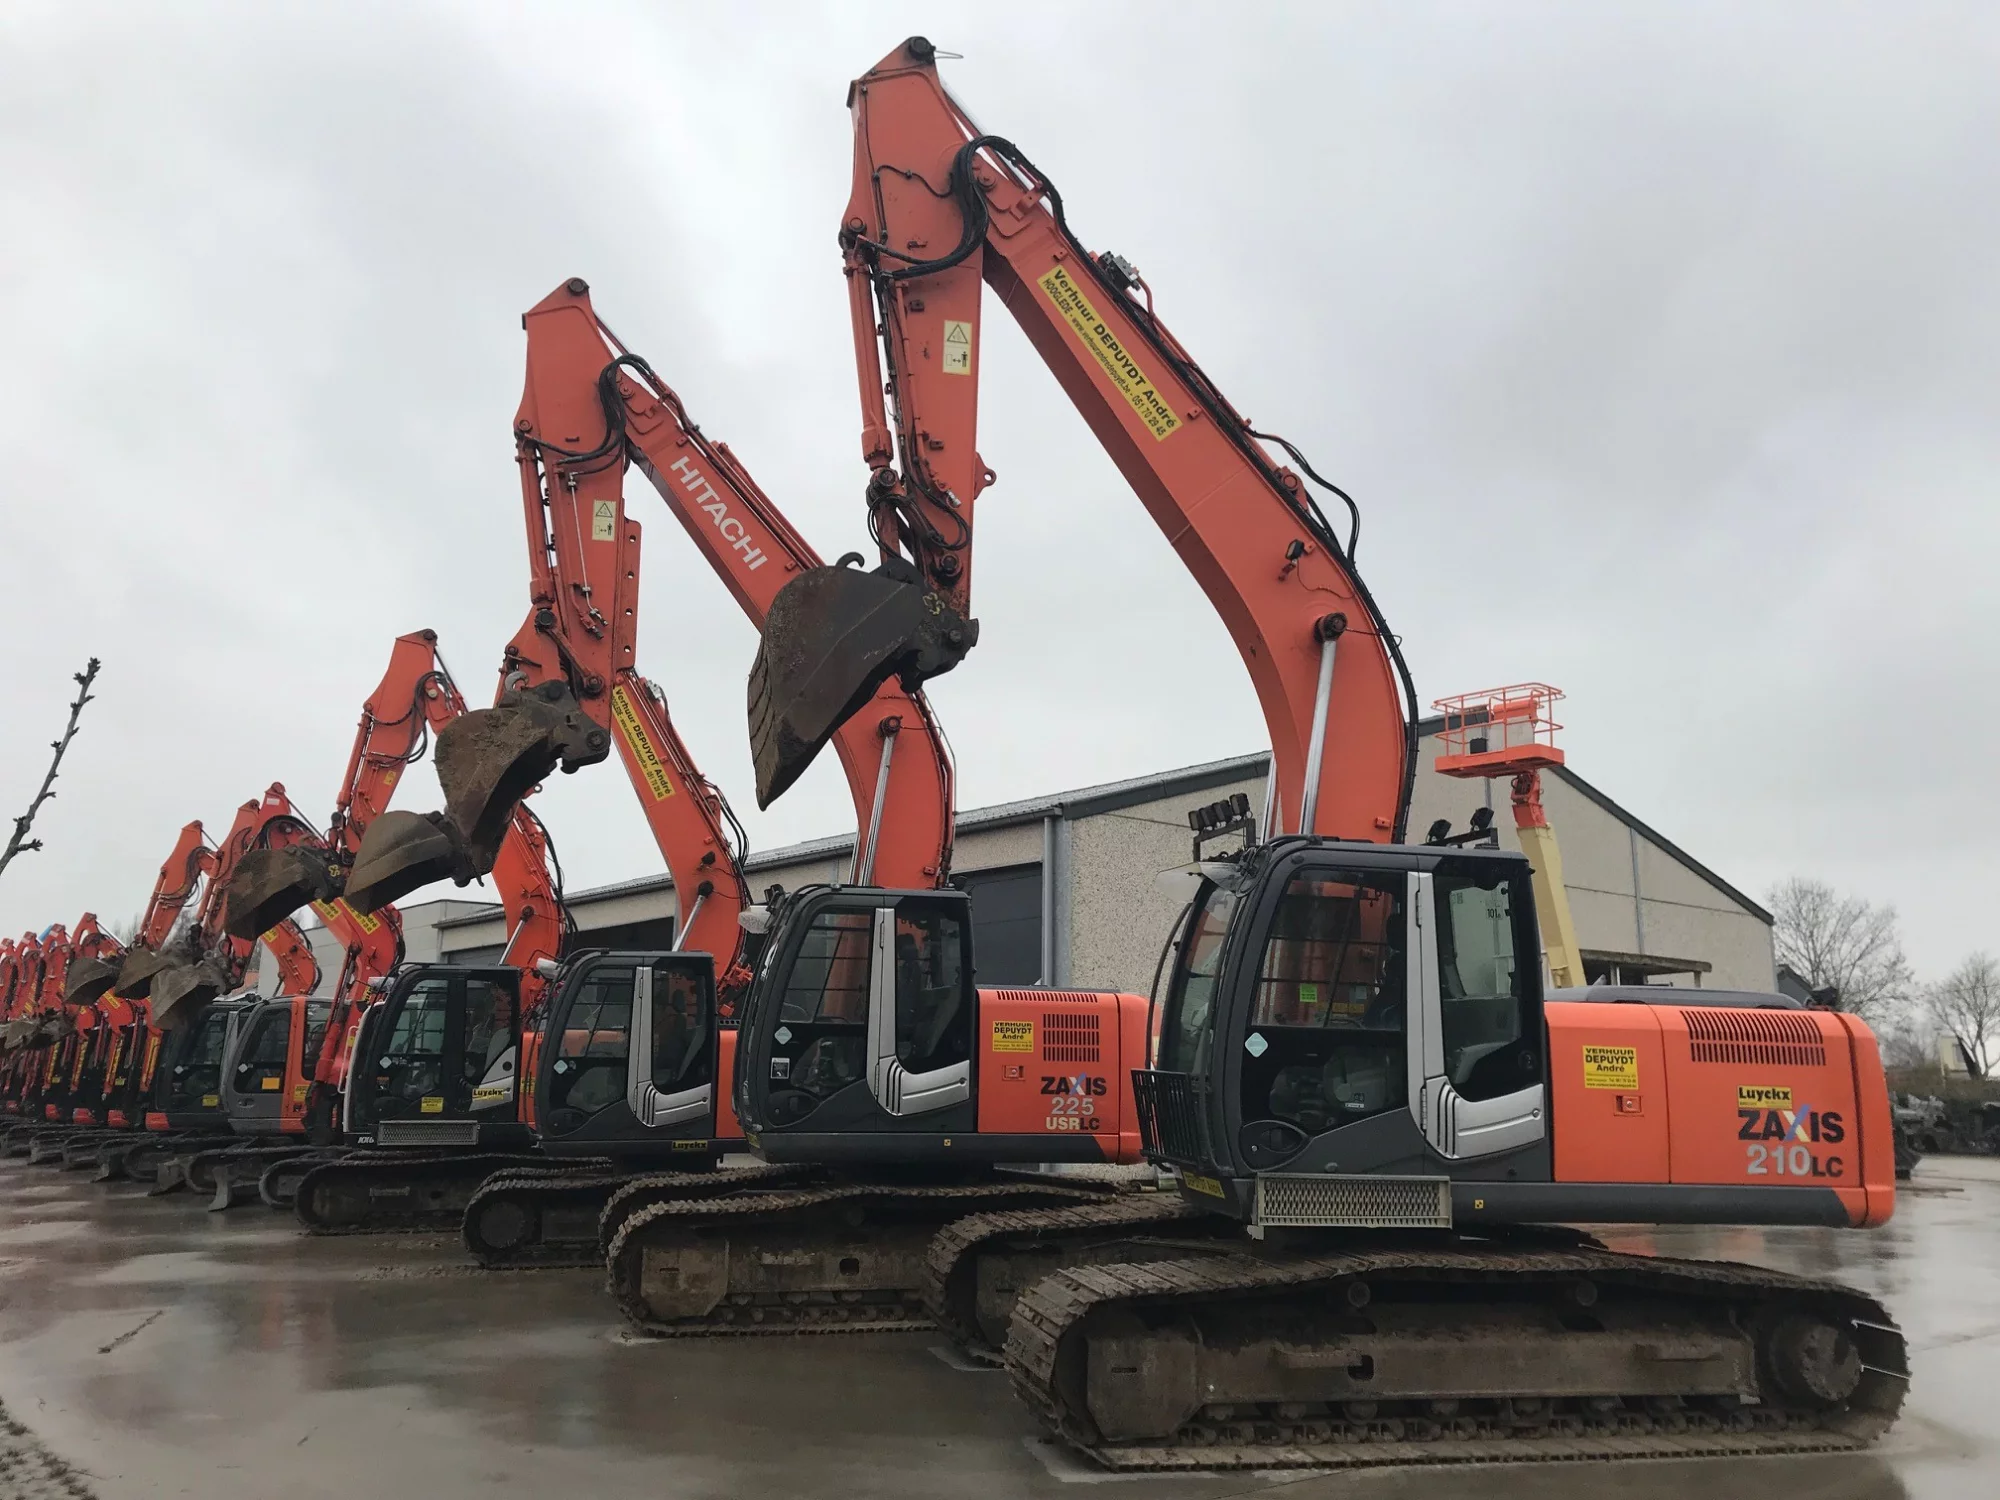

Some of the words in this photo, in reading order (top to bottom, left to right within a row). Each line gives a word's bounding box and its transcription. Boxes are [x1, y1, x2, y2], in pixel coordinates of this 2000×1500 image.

[1054, 269, 1095, 322] Verhuur
[1093, 323, 1146, 386] DEPUYDT
[1142, 389, 1177, 428] André
[1042, 278, 1073, 314] HOOGLEDE
[1131, 394, 1144, 408] 051
[1141, 406, 1152, 418] 70
[1147, 416, 1159, 427] 29
[1155, 425, 1166, 436] 45
[670, 456, 768, 571] HITACHI
[615, 688, 636, 723] Verhuur
[632, 724, 659, 765] DEPUYDT
[654, 768, 672, 794] André
[994, 1026, 1032, 1034] DEPUYDT
[1585, 1047, 1634, 1056] VERHUUR
[1585, 1054, 1635, 1065] DEPUYDT
[1596, 1063, 1625, 1073] André
[1040, 1072, 1107, 1096] ZAXIS
[473, 1089, 503, 1097] Luyckx
[1739, 1086, 1791, 1101] Luyckx
[1051, 1096, 1094, 1115] 225
[1045, 1116, 1100, 1130] USRLC
[1738, 1103, 1845, 1143] ZAXIS
[672, 1141, 707, 1150] Luyckx
